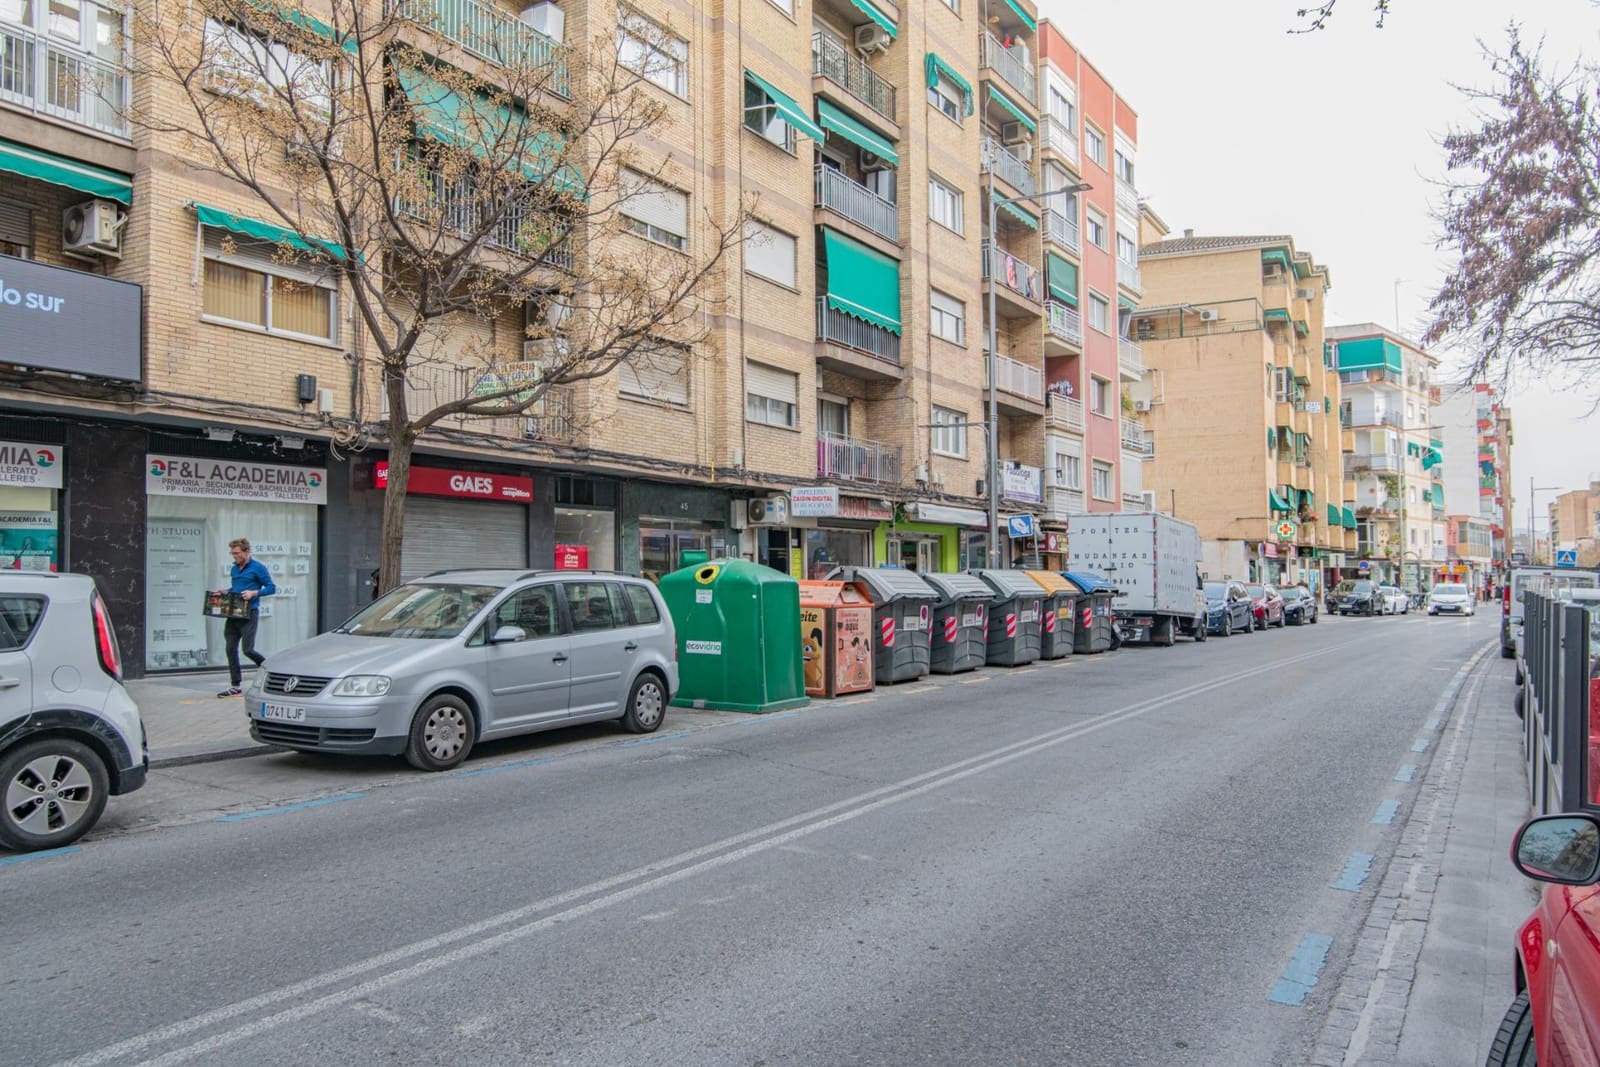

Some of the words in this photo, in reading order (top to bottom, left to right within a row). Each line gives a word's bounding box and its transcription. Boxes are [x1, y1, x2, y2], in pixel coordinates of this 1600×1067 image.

[25, 292, 65, 313] sur
[167, 461, 206, 479] F&L
[210, 464, 308, 487] ACADEMIA
[162, 479, 200, 487] PRIMARIA
[206, 481, 254, 490] SECUNDARIA
[259, 485, 311, 494] BACHILLERATO
[450, 474, 493, 495] GAES
[182, 486, 234, 496] UNIVERSIDAD
[239, 490, 269, 498] IDIOMAS
[275, 492, 309, 500] TALLERES
[1081, 527, 1139, 535] PORTES
[1074, 552, 1148, 560] MUDANZAS
[286, 707, 305, 720] LJF
